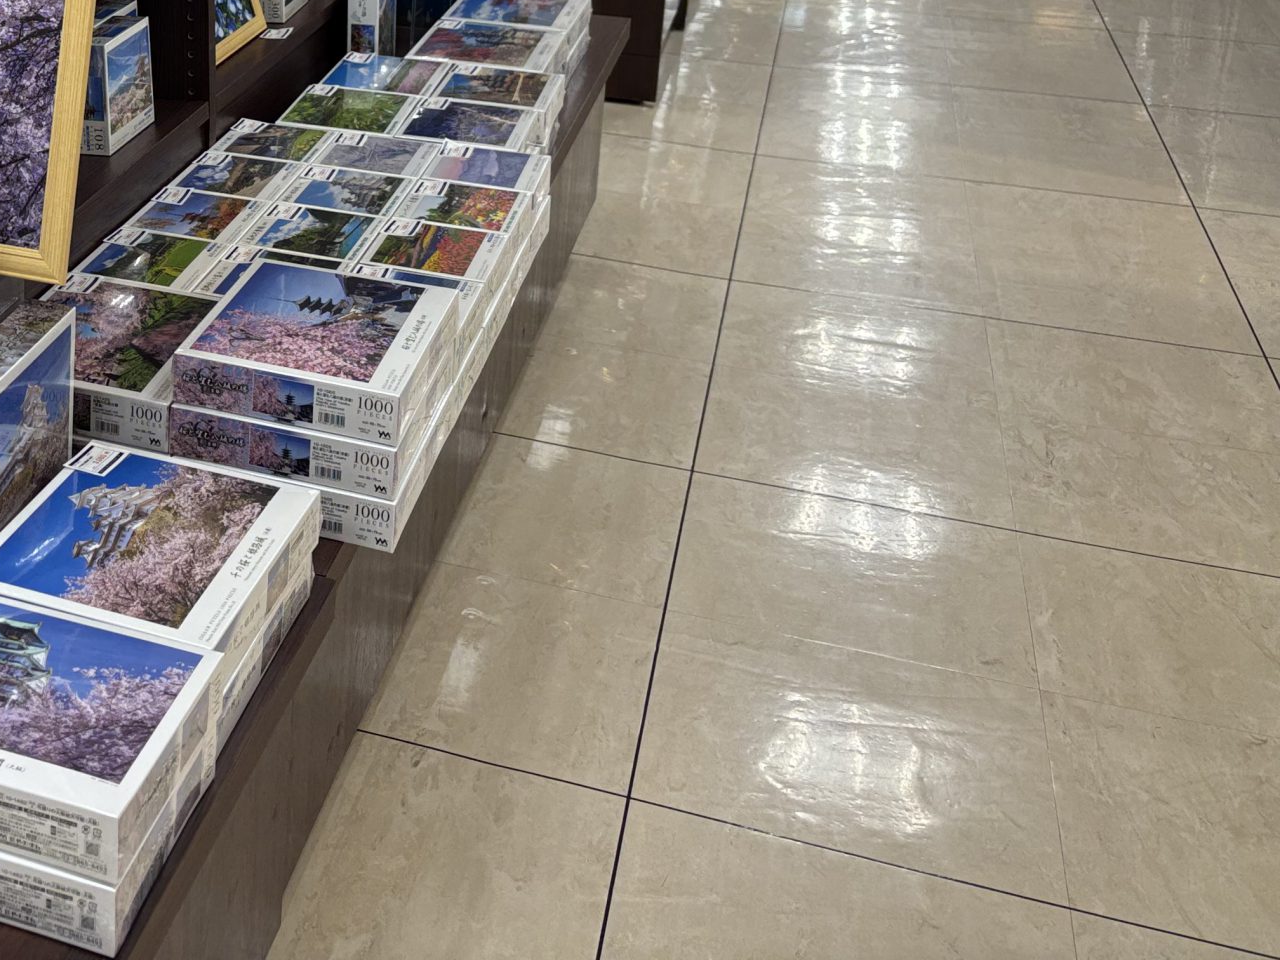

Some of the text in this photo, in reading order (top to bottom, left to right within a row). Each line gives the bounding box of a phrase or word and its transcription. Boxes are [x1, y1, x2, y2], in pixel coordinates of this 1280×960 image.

[129, 404, 163, 423] 1000
[358, 396, 395, 416] 1000
[353, 450, 390, 470] 1000
[354, 503, 391, 523] 1000
